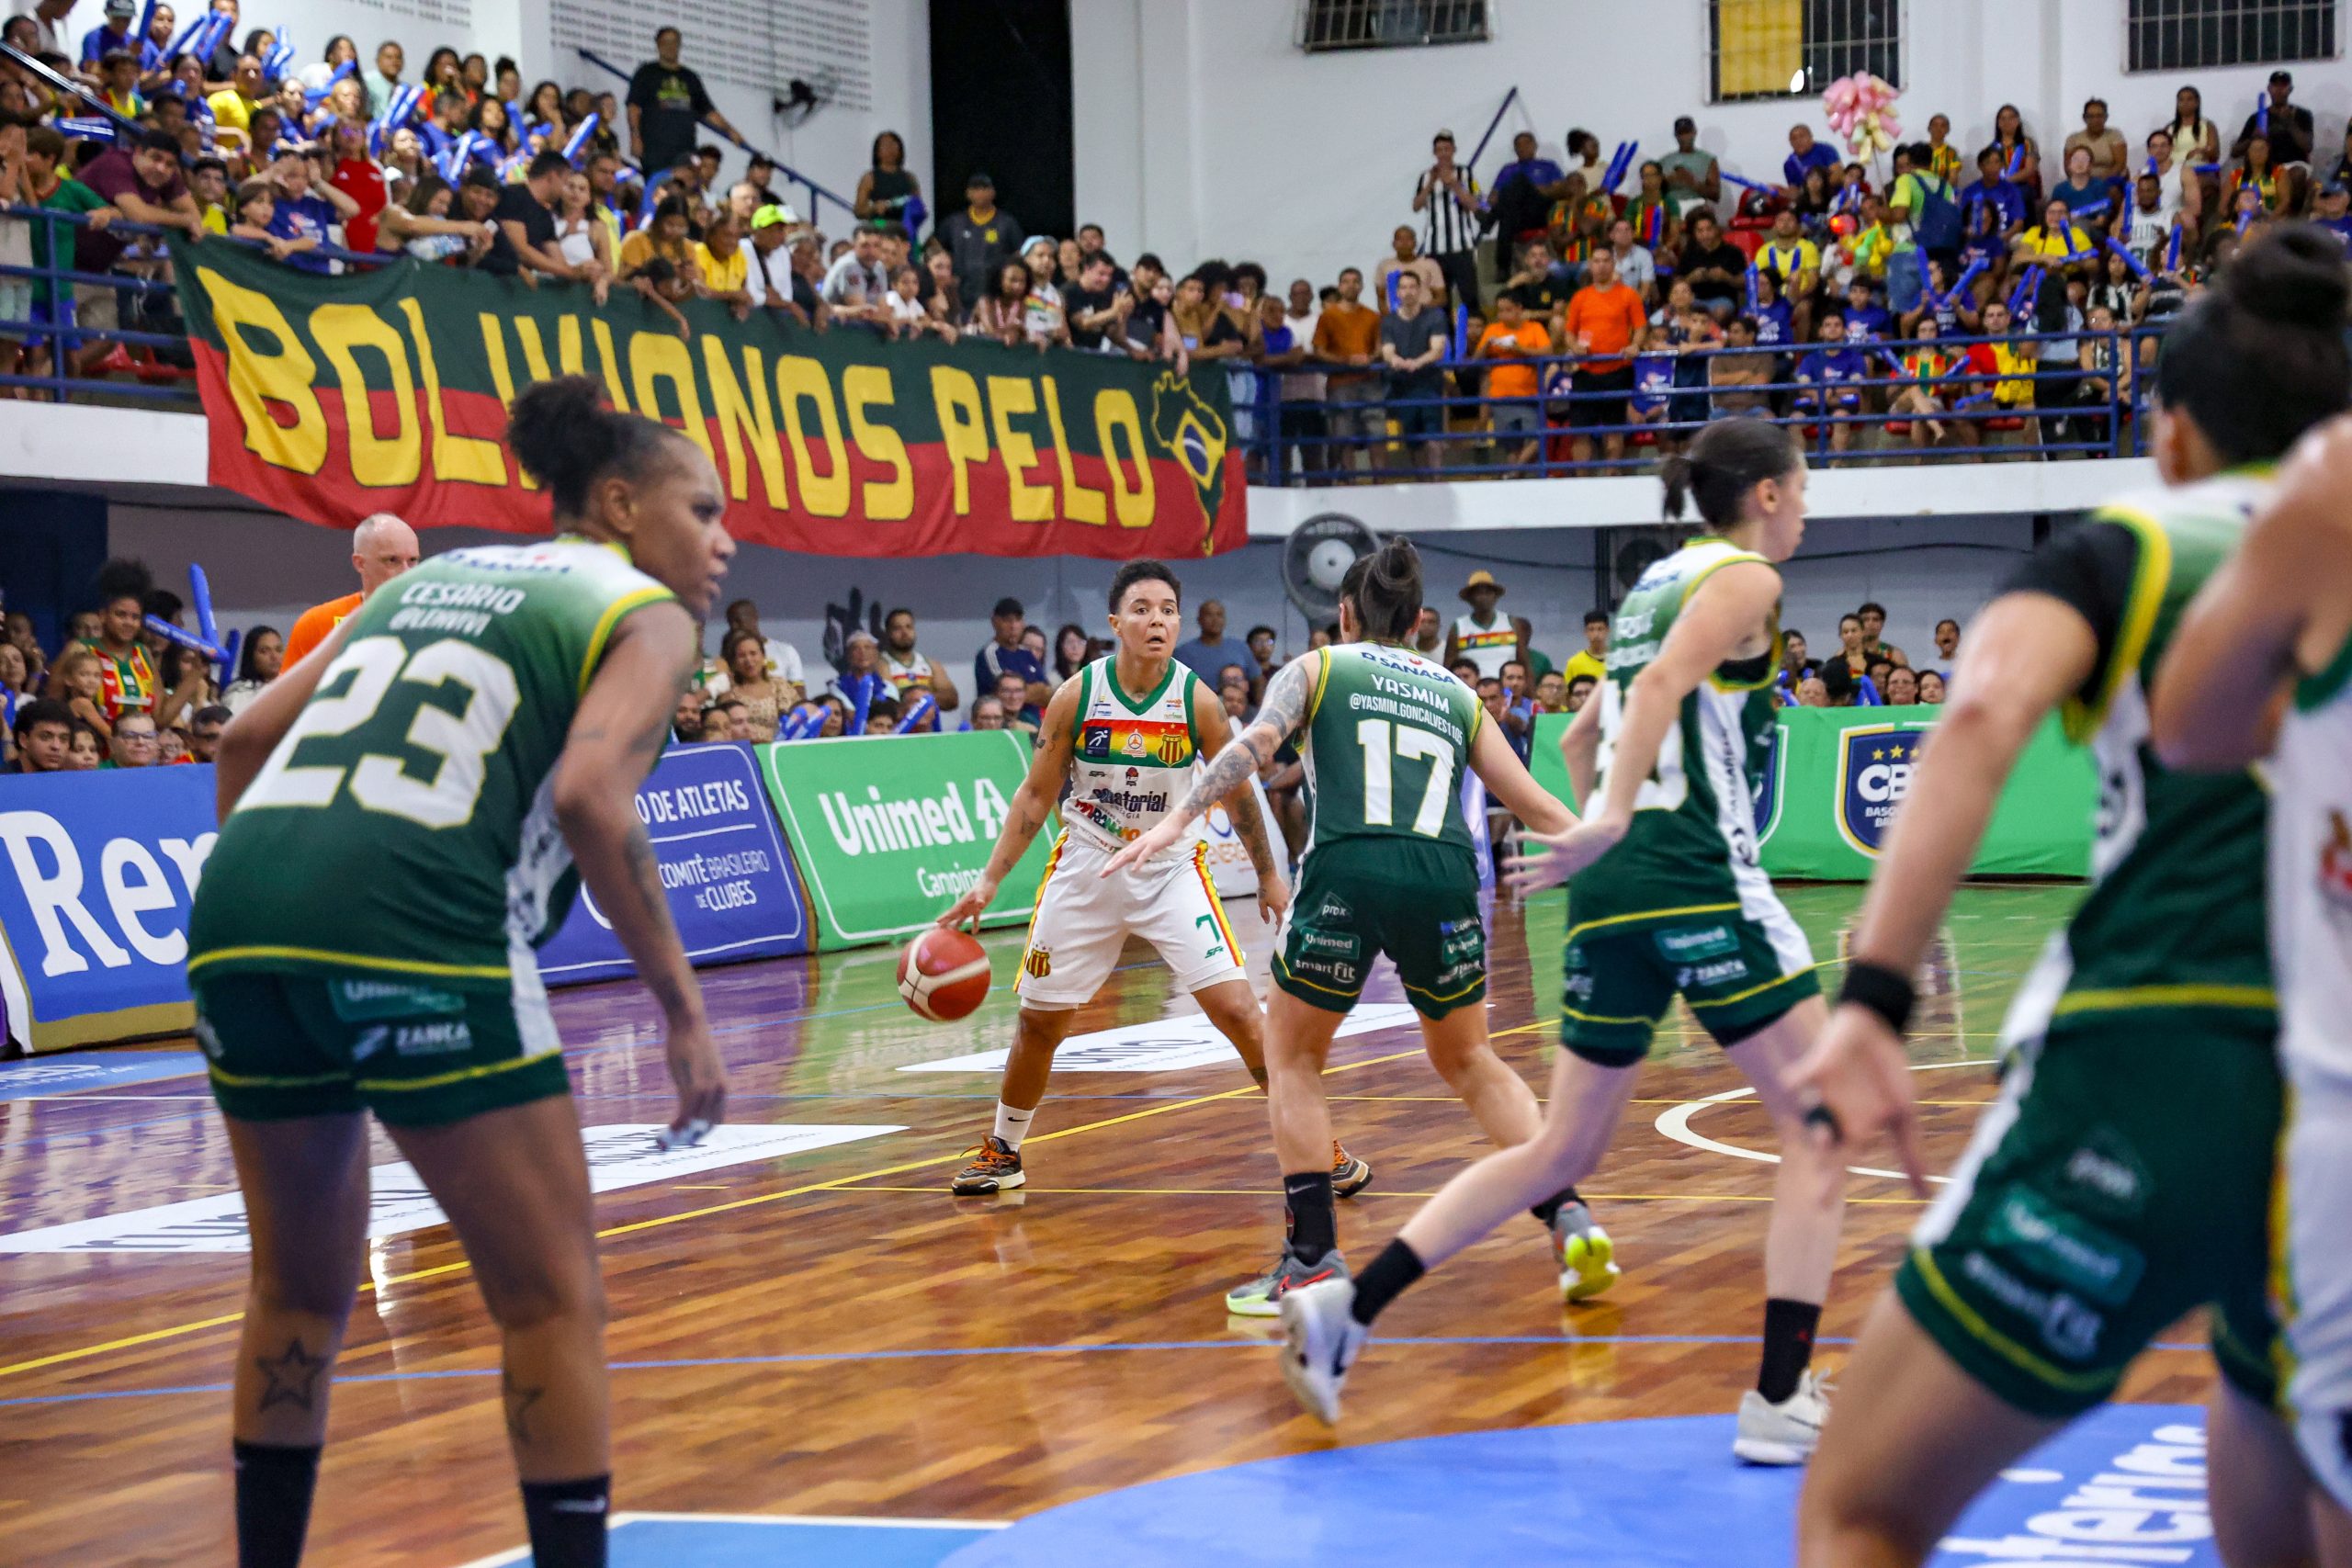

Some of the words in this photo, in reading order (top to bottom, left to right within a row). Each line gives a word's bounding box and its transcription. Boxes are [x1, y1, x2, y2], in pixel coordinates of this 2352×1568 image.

[929, 365, 1156, 527] PELO
[1370, 673, 1450, 715] YASMIM
[232, 636, 522, 831] 23
[1357, 718, 1455, 838] 17
[648, 790, 679, 823] DE
[675, 779, 750, 819] ATLETAS
[818, 781, 976, 856] Unimed
[658, 852, 711, 889] COMITÊ
[707, 850, 771, 880] BRASILEIRO
[705, 879, 758, 912] CLUBES
[1195, 913, 1221, 942] 7
[1305, 933, 1353, 950] Unimed
[1295, 959, 1332, 974] smart
